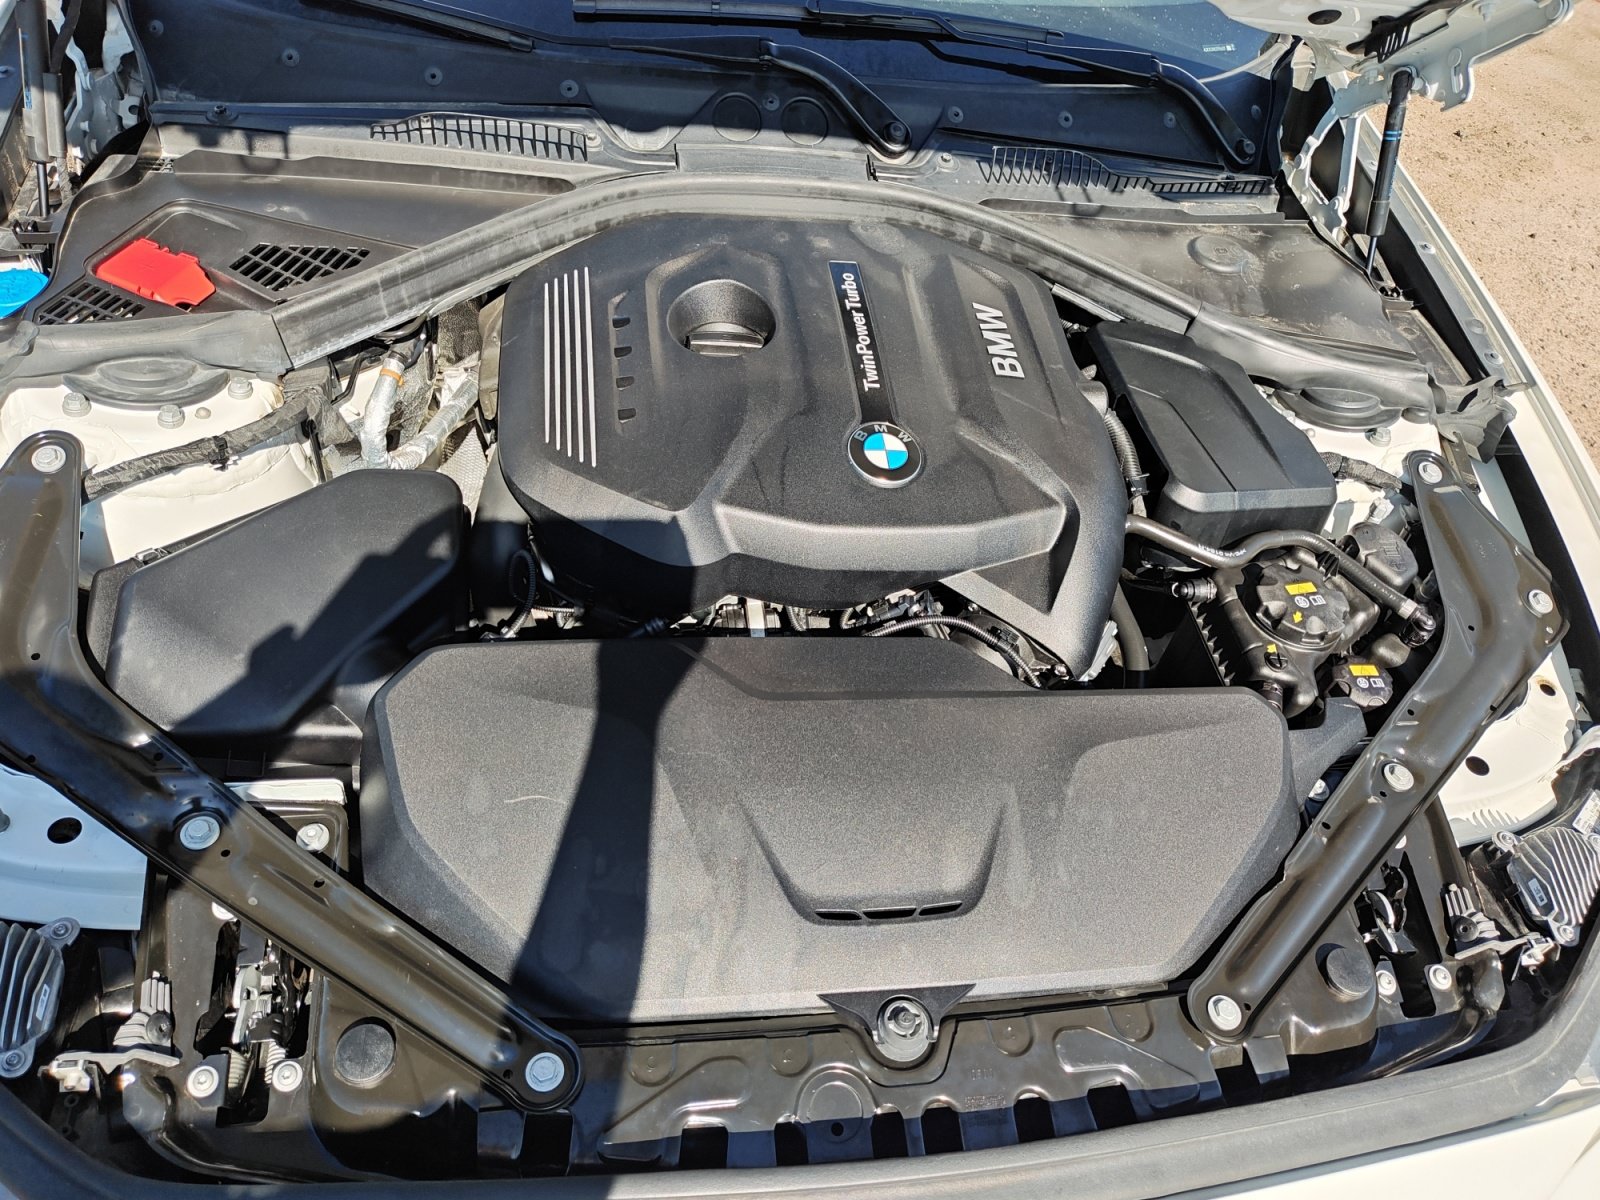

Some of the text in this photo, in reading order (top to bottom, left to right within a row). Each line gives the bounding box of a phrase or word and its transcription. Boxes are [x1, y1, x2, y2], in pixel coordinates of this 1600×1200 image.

[841, 272, 881, 393] TwinPower Turbo
[971, 302, 1026, 380] BMW
[854, 424, 912, 443] BMW
